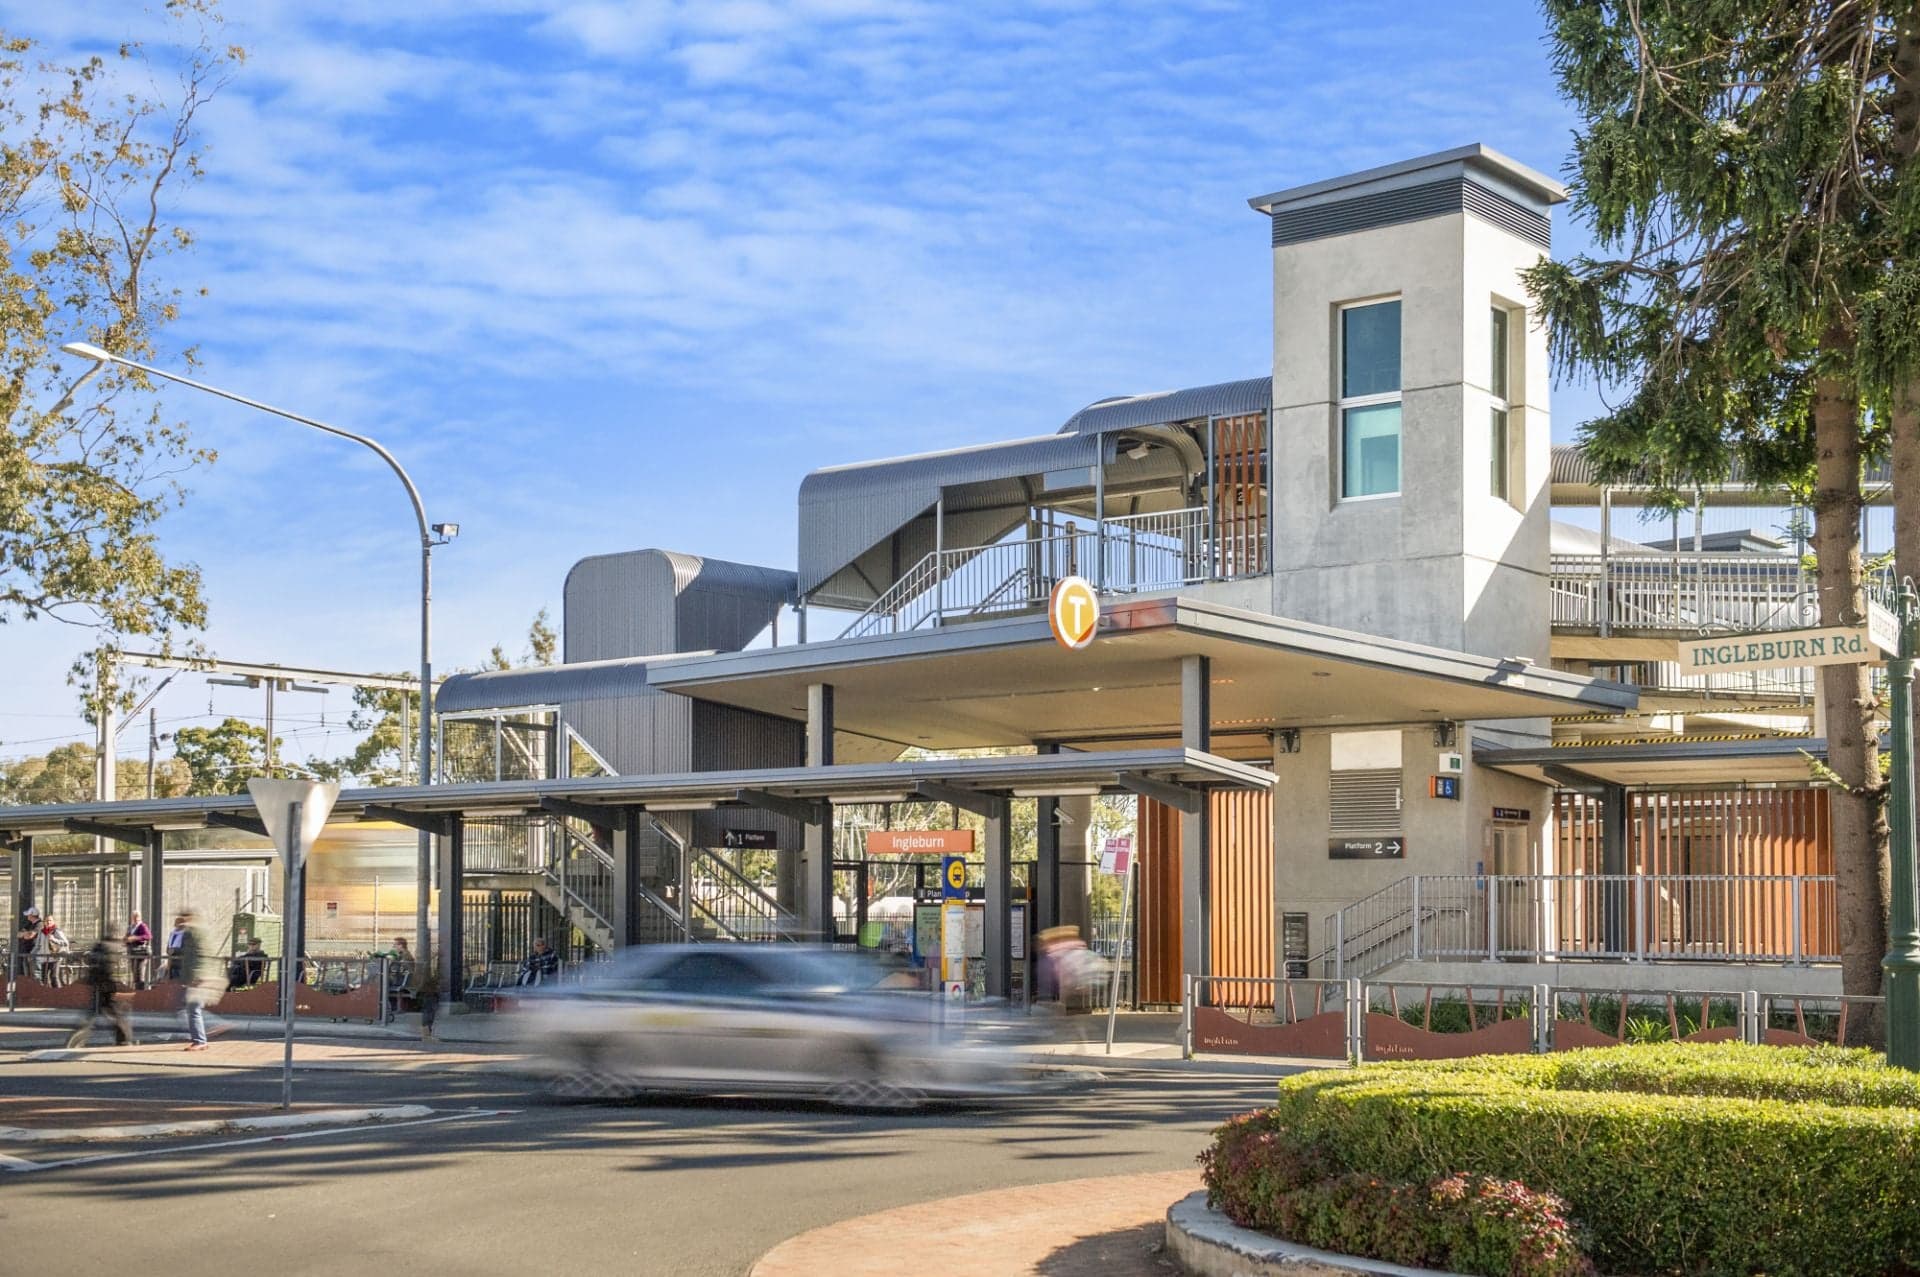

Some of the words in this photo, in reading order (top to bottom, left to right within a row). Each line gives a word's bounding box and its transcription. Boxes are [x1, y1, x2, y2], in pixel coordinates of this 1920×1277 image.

[1068, 595, 1087, 635] T
[1692, 637, 1826, 667] INGLEBURN
[1832, 633, 1868, 655] Rd.
[738, 833, 743, 845] 1
[892, 835, 945, 851] Ingleburn
[1374, 841, 1383, 854] 2
[927, 889, 942, 897] Plan
